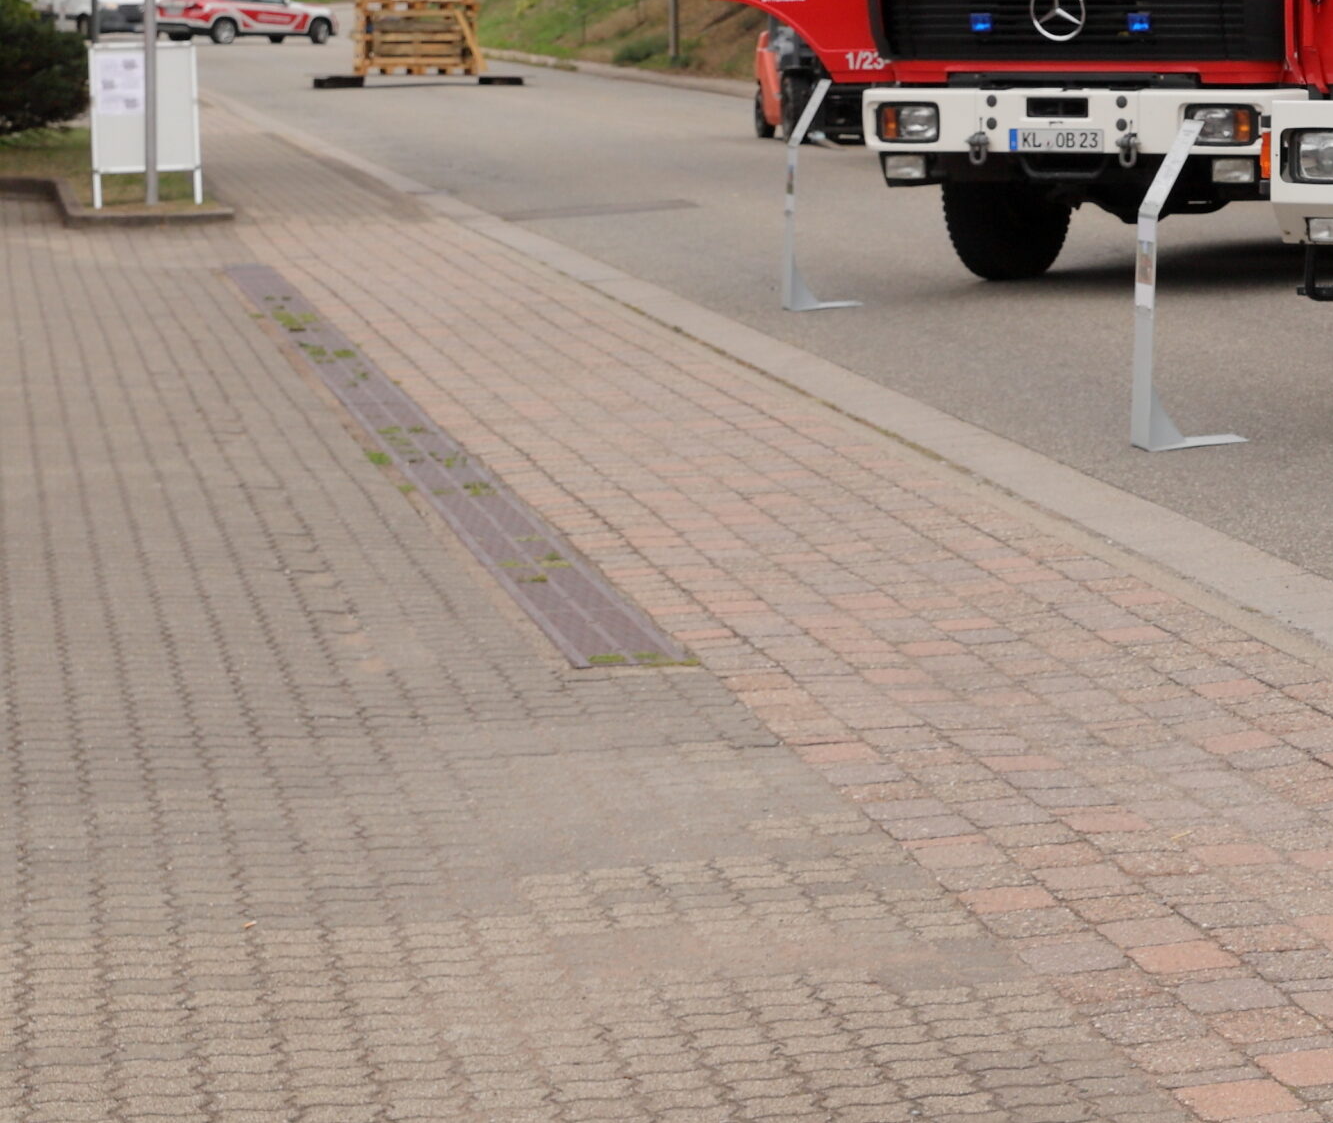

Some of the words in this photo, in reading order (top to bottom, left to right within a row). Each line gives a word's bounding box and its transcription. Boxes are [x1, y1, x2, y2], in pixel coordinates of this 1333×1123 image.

[1022, 132, 1042, 148] KL
[1056, 132, 1075, 148] OB
[1080, 132, 1098, 148] 23
